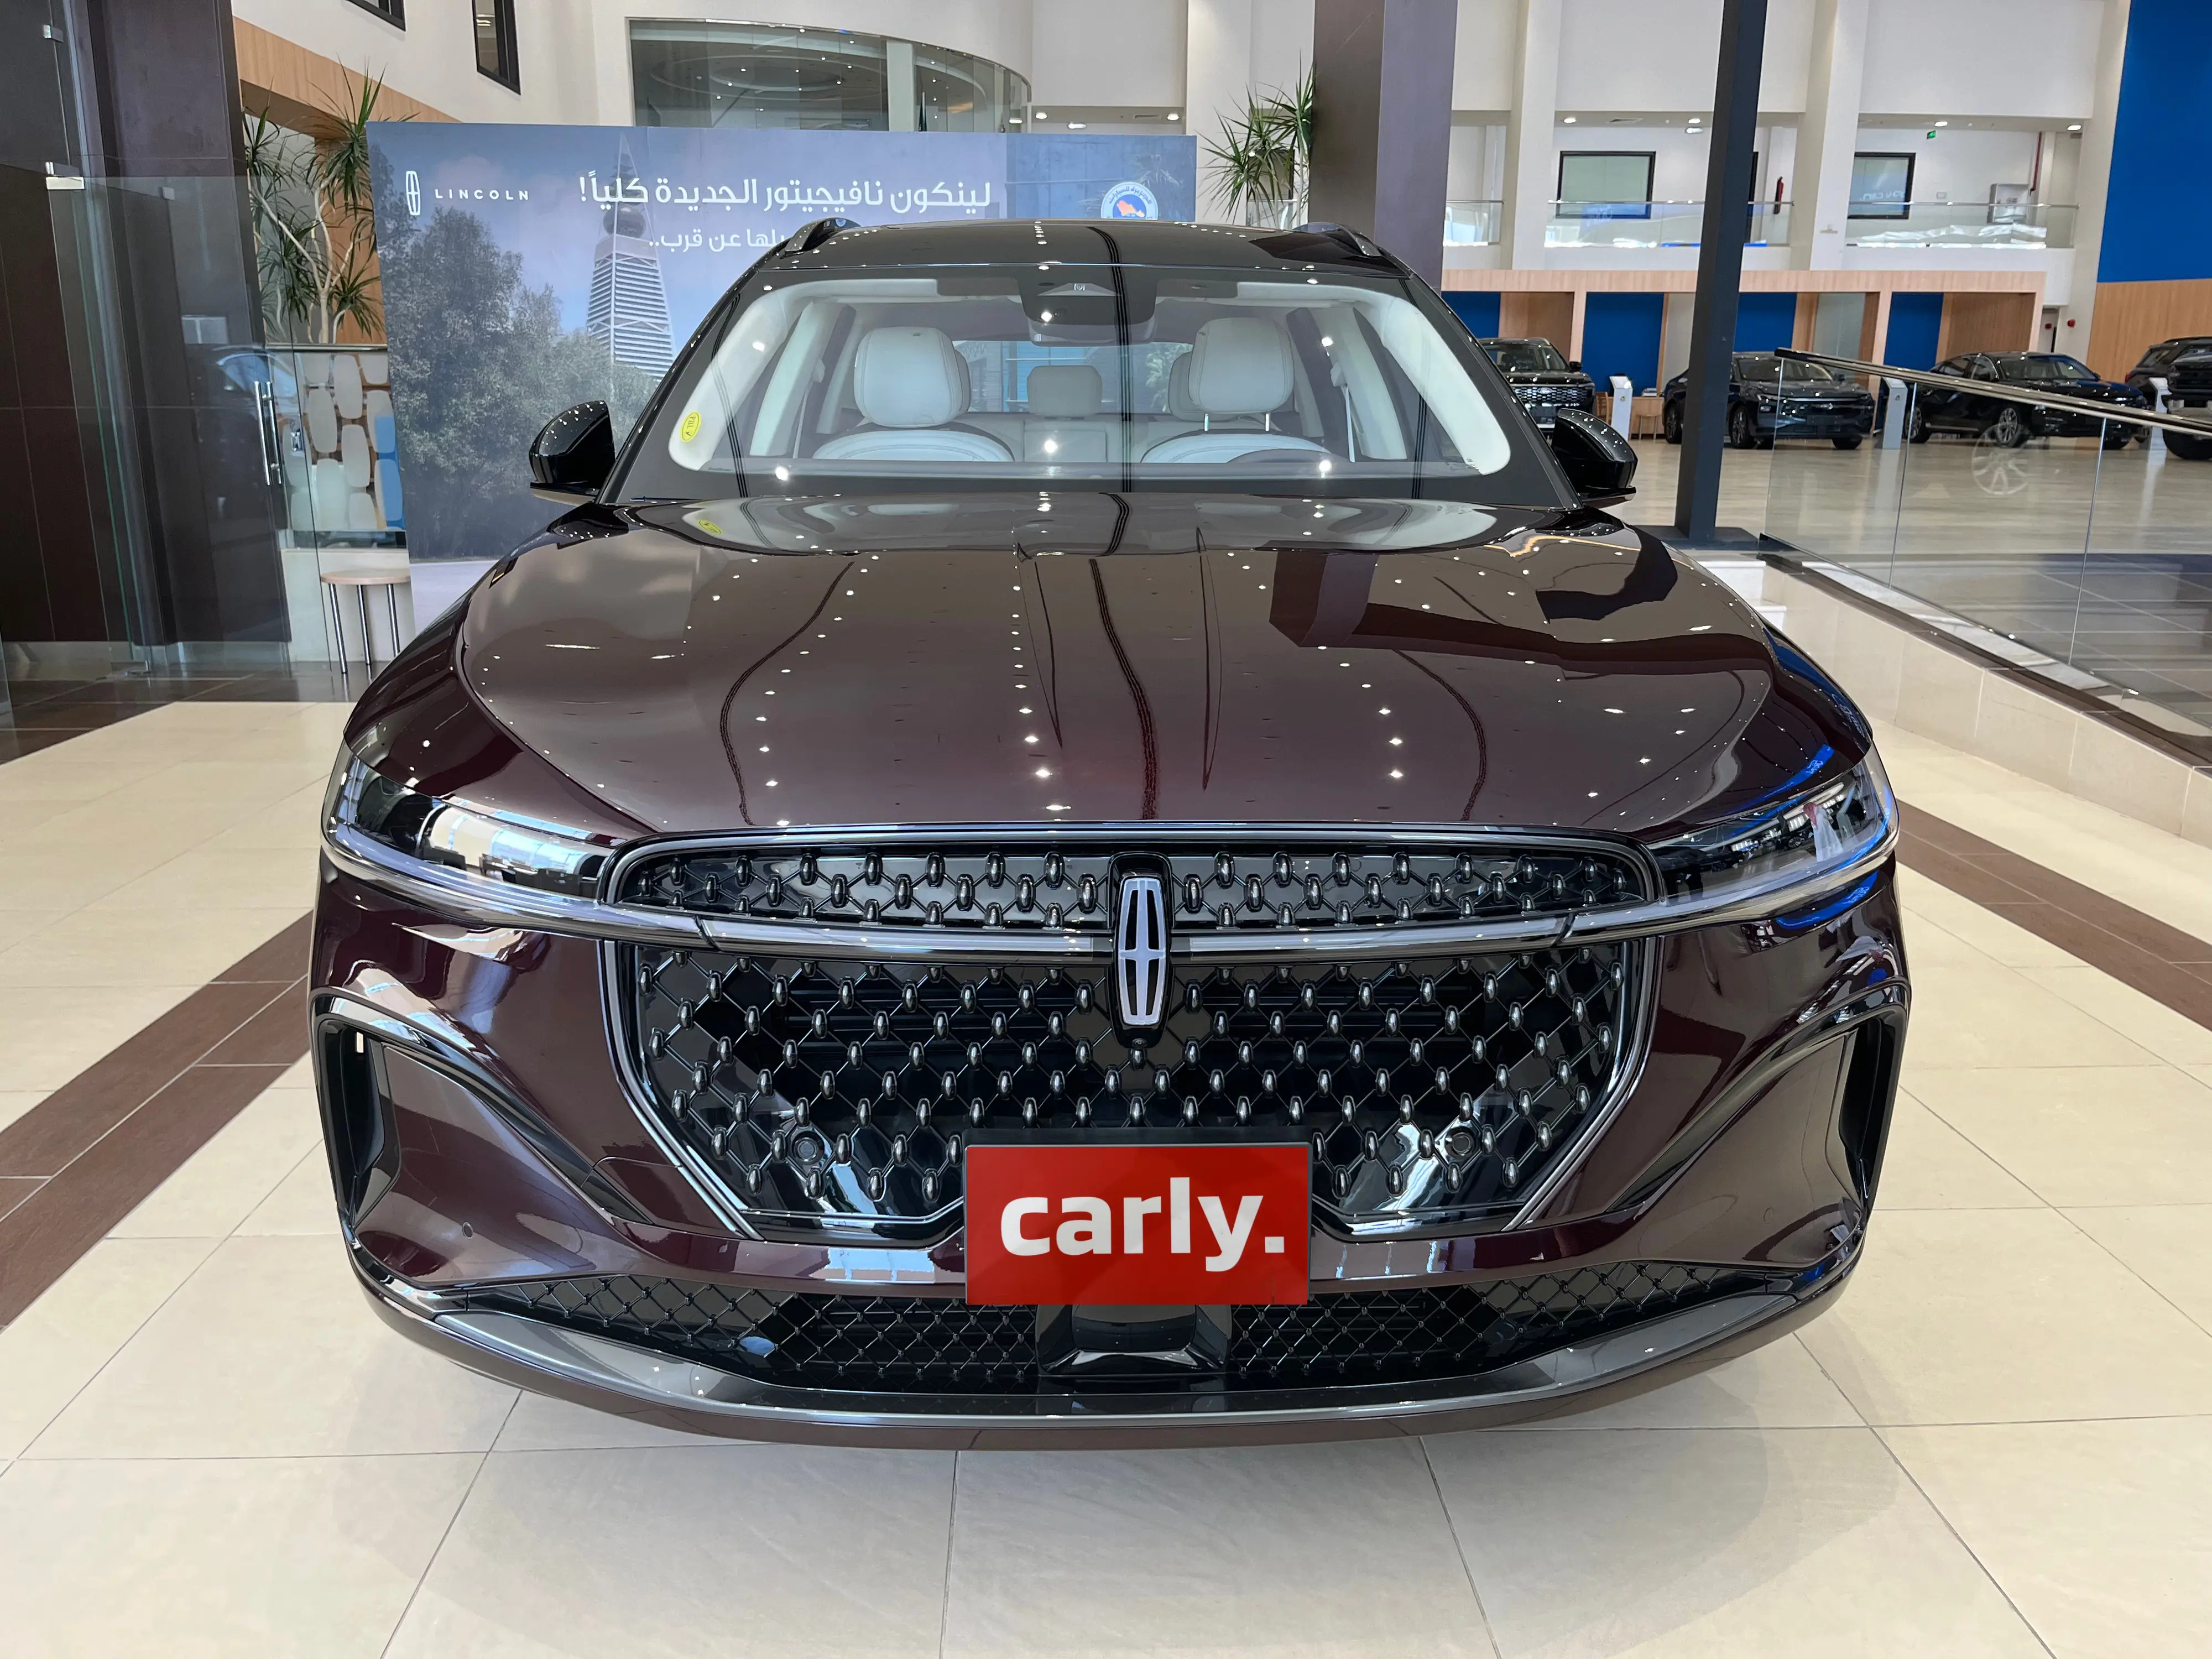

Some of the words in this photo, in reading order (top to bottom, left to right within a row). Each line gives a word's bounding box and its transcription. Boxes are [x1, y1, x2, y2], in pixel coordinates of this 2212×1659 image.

[435, 188, 529, 201] LINCOLN
[655, 178, 758, 211] الجديدة
[764, 179, 884, 212] نافيجيتور
[890, 181, 990, 214] لينكون
[708, 233, 742, 252] عن
[1000, 1177, 1285, 1272] carly.
